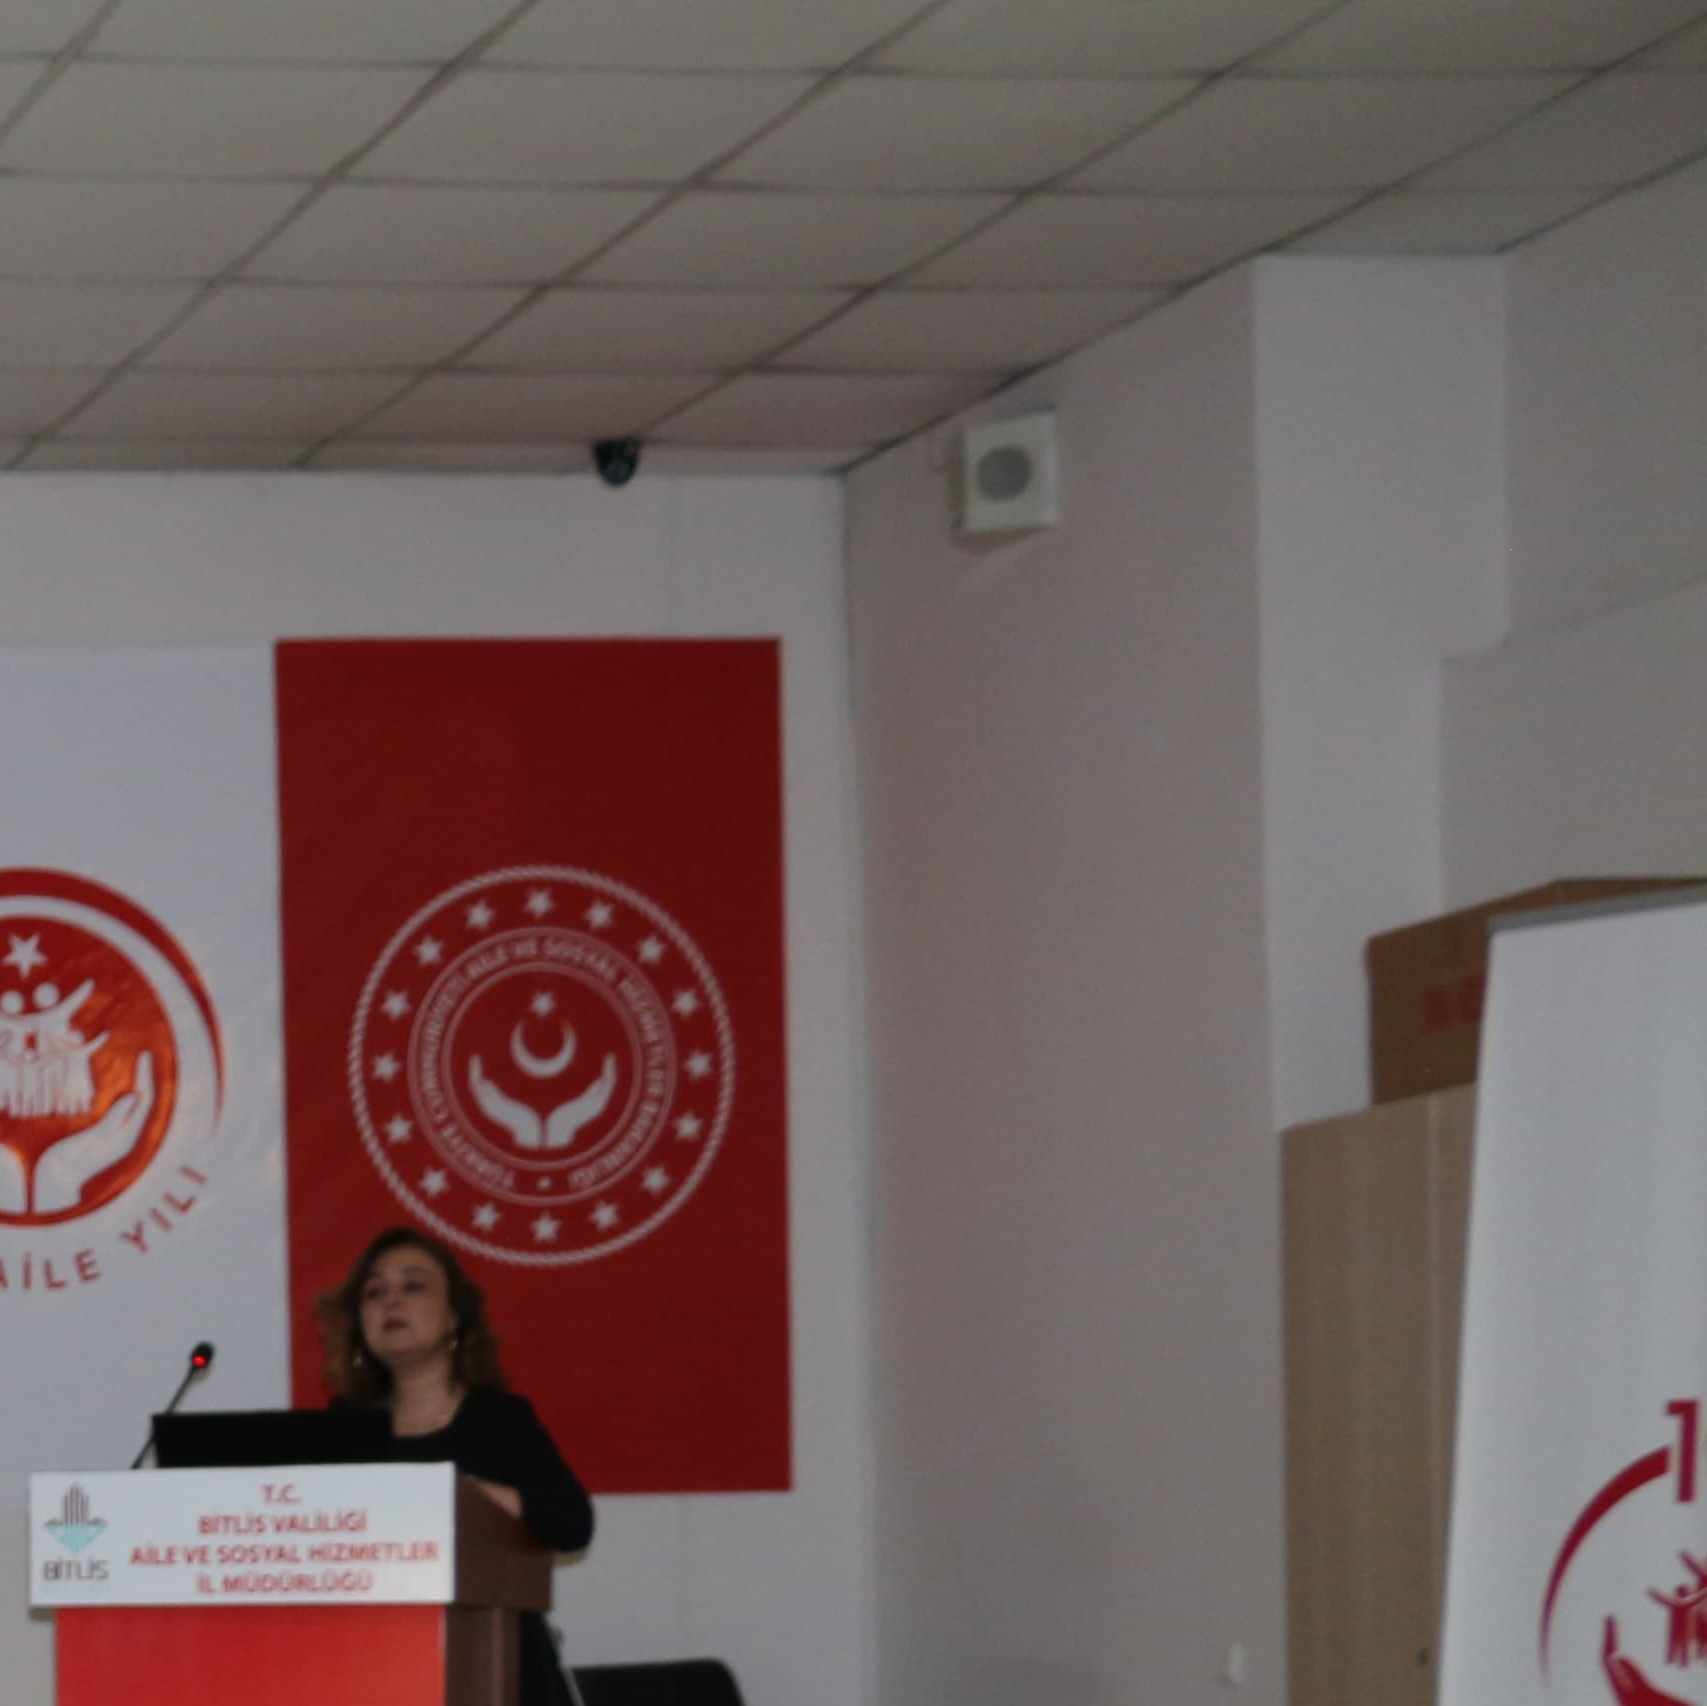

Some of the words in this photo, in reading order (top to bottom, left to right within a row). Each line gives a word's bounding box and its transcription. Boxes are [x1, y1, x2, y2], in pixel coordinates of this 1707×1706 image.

[120, 1155, 209, 1253] YILI
[1666, 1399, 1707, 1503] 1
[261, 1483, 302, 1504] T.C.
[198, 1511, 268, 1537] BİTLİS
[129, 1543, 178, 1567] AİLE
[184, 1544, 209, 1565] VE
[216, 1543, 302, 1565] SOSYAL
[307, 1540, 440, 1563] HİZMETLER
[43, 1555, 109, 1581] BİTLİS
[196, 1571, 217, 1594] İL
